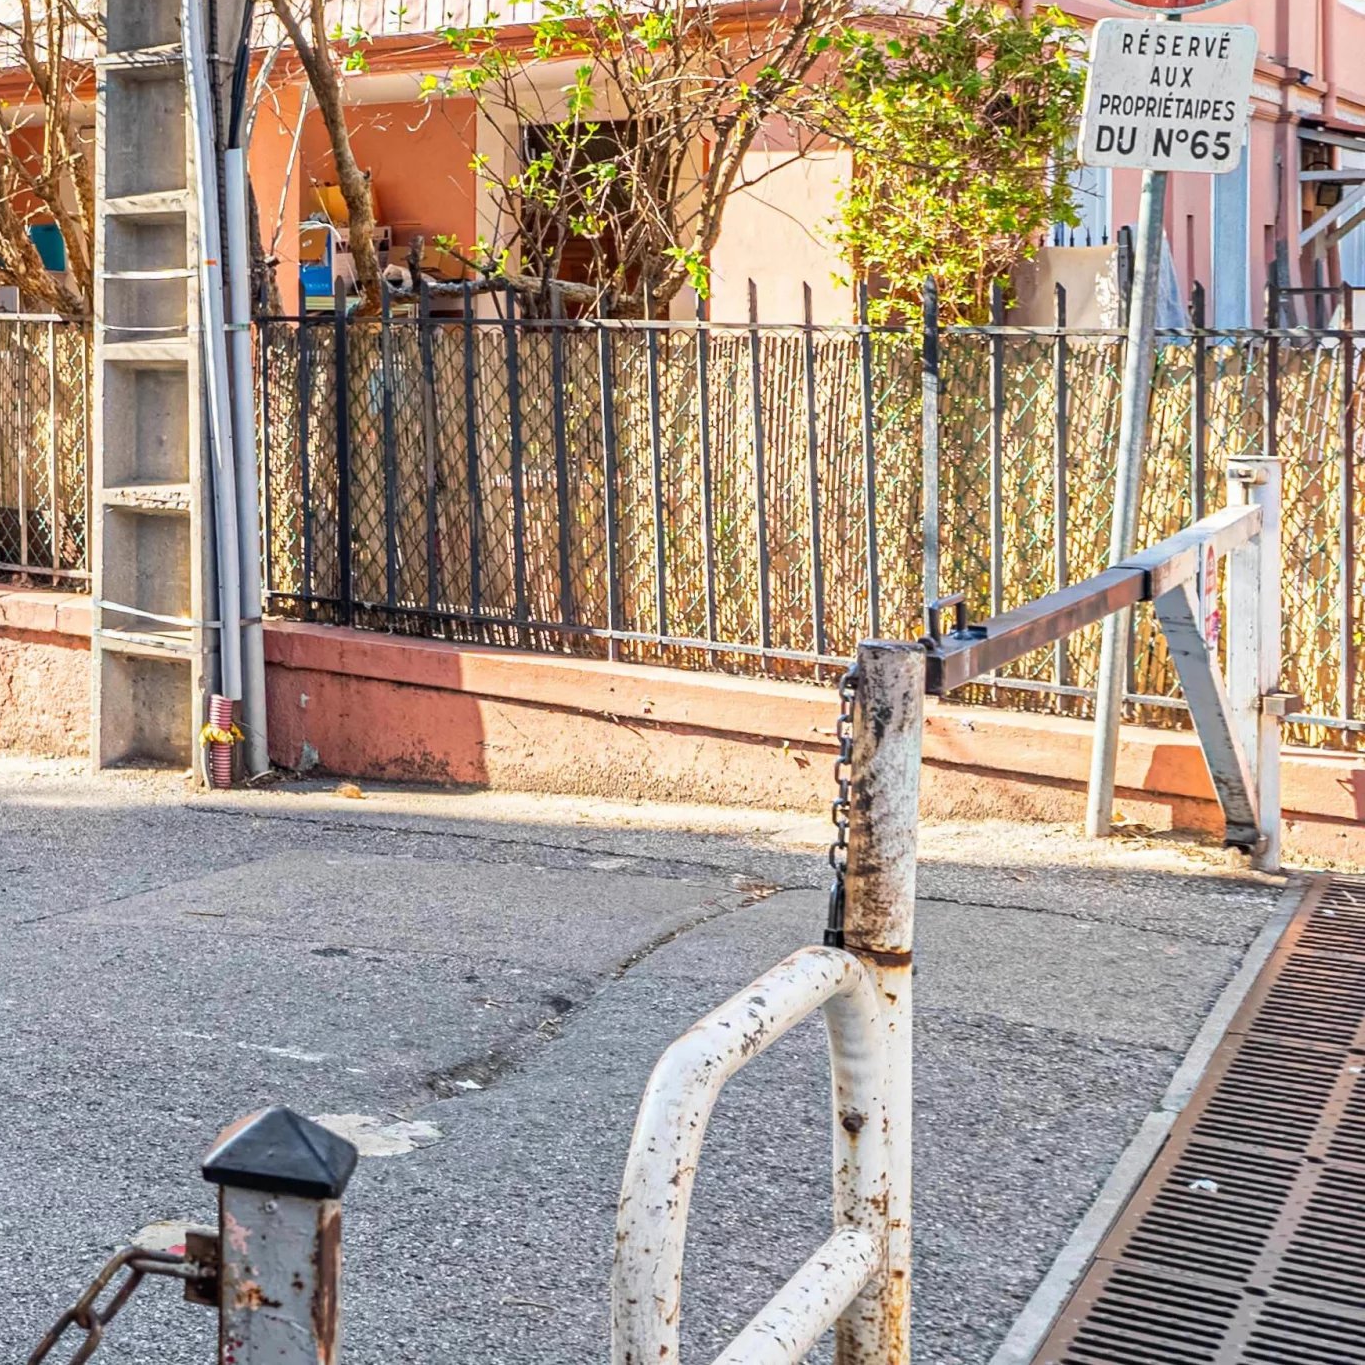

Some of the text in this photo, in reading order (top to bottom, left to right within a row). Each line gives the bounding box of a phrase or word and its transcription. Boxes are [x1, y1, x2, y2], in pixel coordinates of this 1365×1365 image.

[1122, 28, 1231, 59] RÉSERVÉ
[1150, 66, 1193, 88] AUX
[1098, 92, 1236, 122] PROPRIÉTAIRES
[1095, 125, 1231, 160] DU N°65
